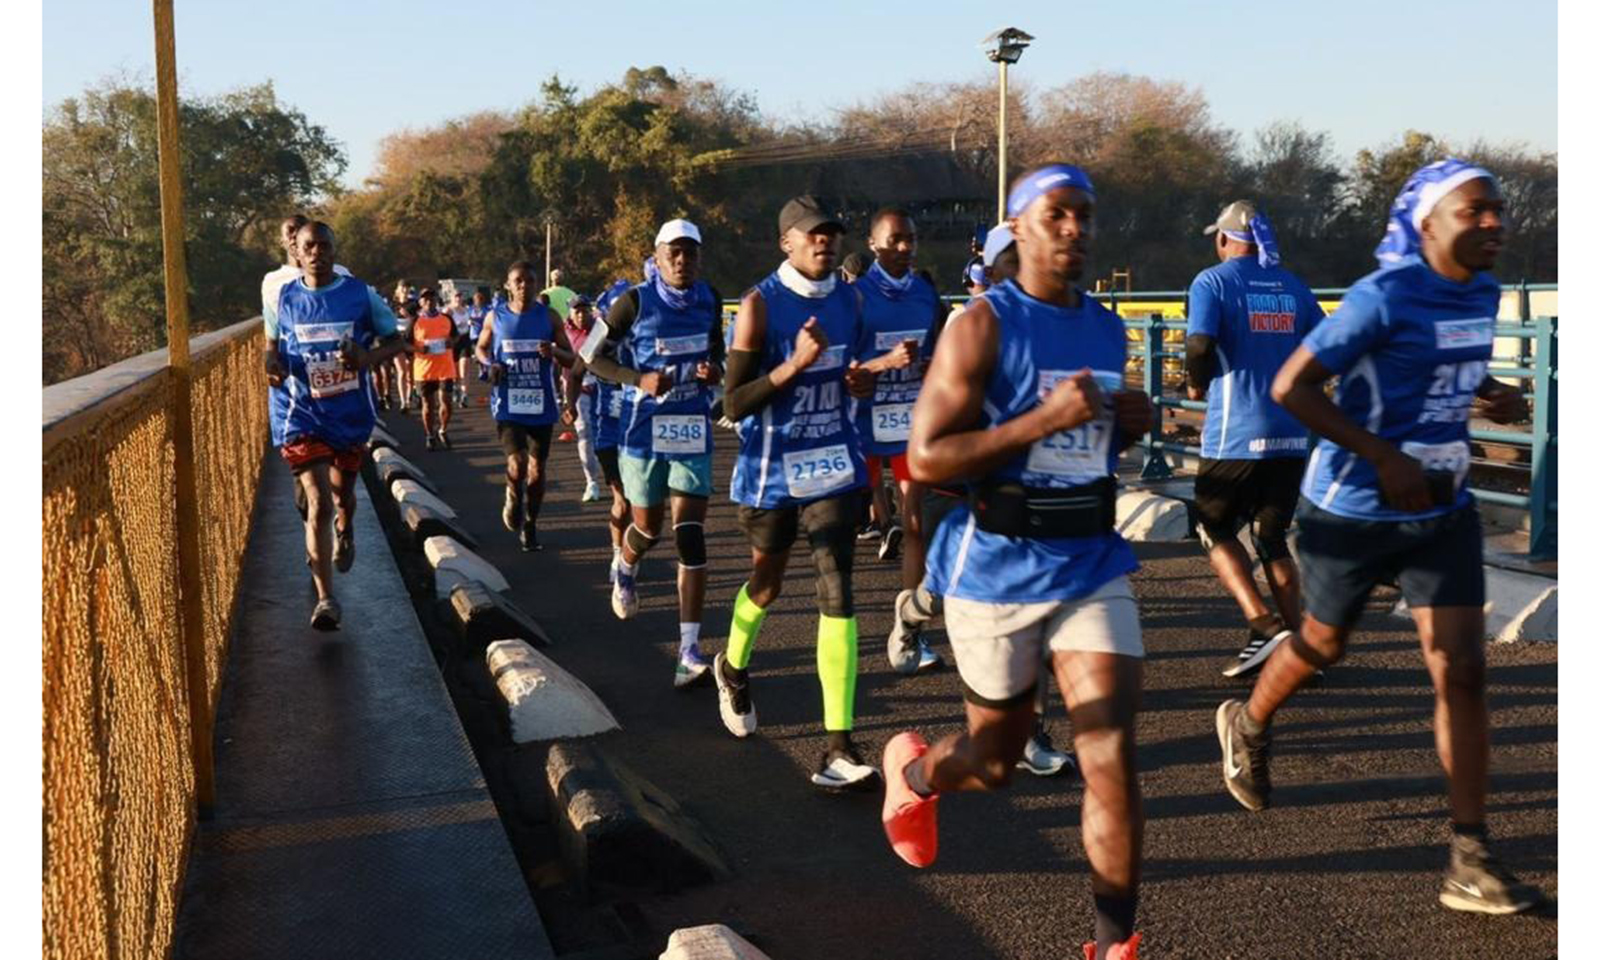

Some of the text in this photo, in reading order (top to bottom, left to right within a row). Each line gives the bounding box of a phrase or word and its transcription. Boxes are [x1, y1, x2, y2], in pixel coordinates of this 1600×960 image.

[1246, 294, 1296, 313] ROAD TO
[1249, 313, 1295, 333] VICTORY
[511, 394, 541, 406] 3446
[792, 385, 816, 413] 21
[878, 412, 911, 429] 254
[658, 424, 702, 440] 2548
[792, 457, 846, 480] 2736
